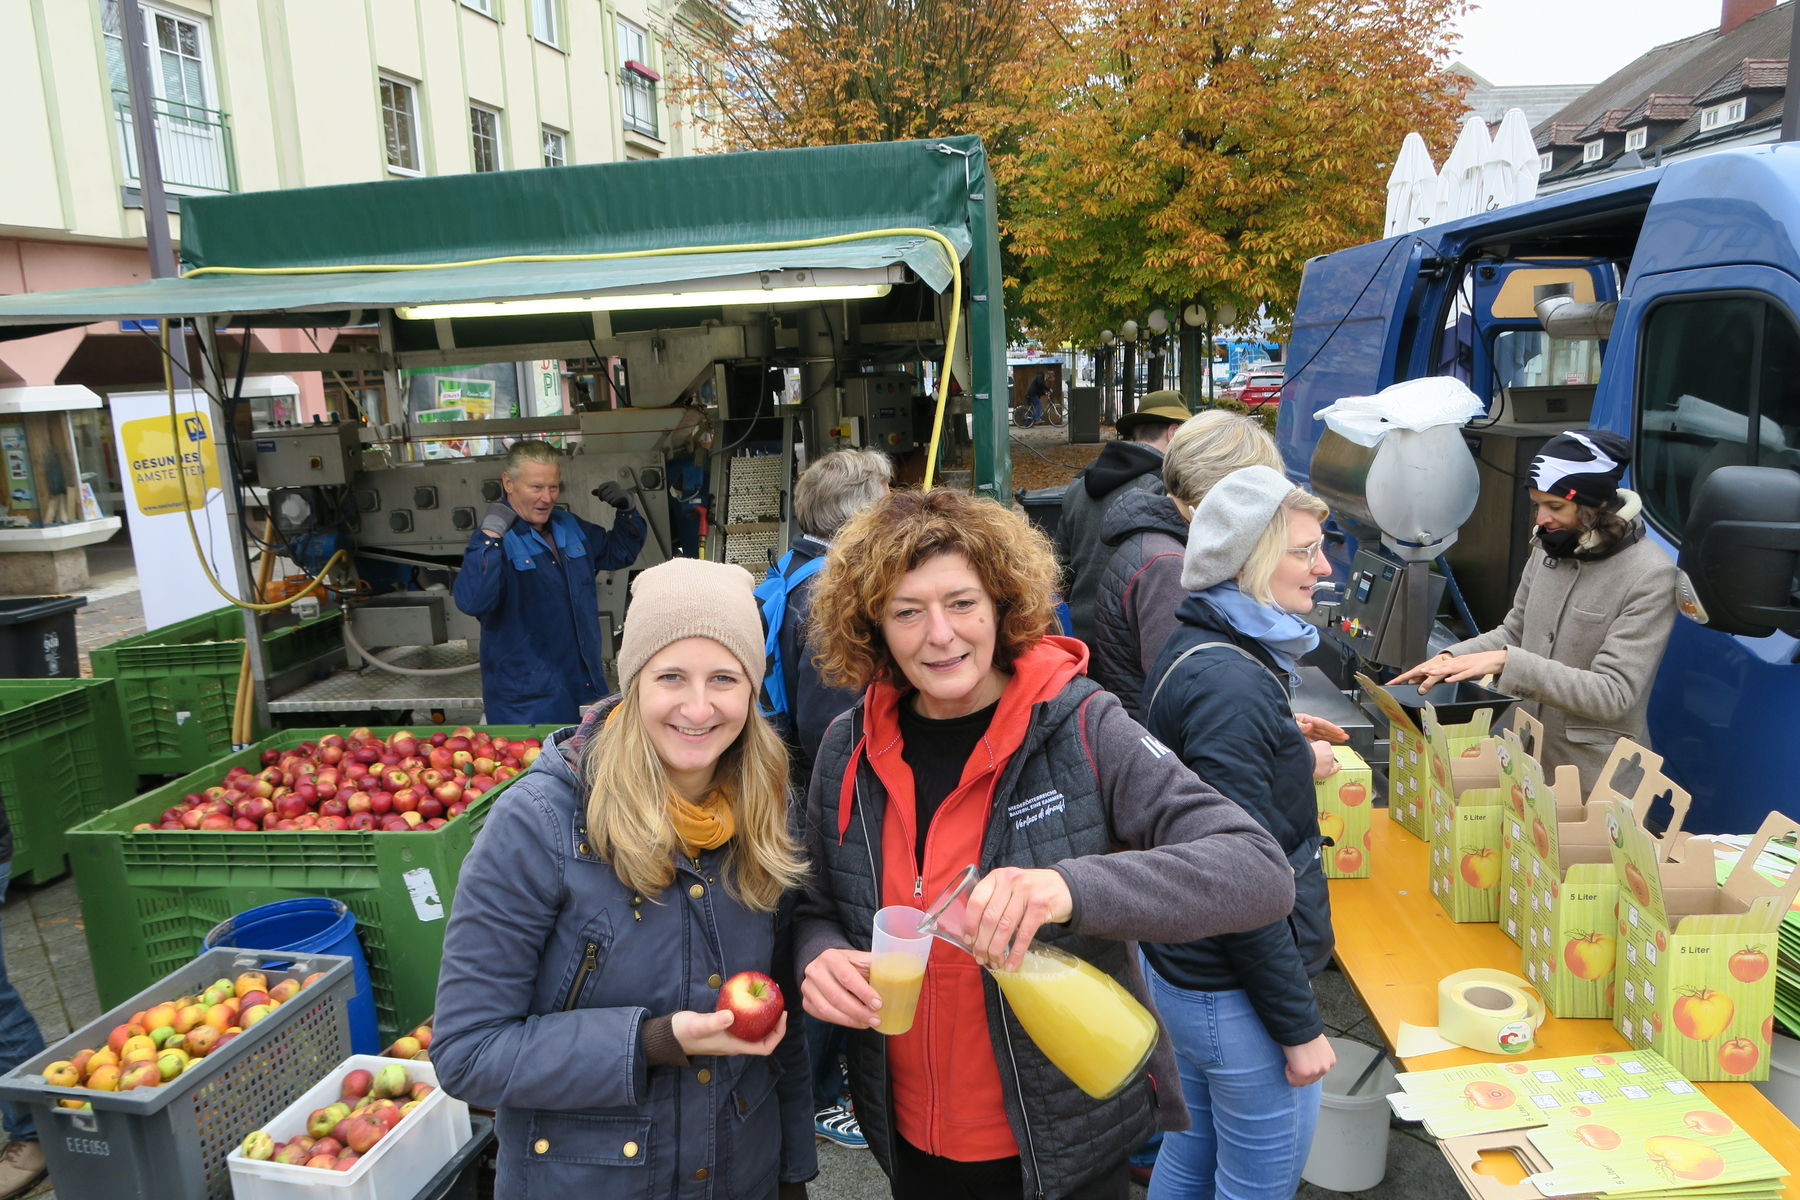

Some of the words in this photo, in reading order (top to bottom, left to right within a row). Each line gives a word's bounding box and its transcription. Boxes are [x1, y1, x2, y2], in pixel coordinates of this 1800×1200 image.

[136, 463, 206, 483] AMSTETEN
[1570, 893, 1576, 901] 5
[1577, 893, 1597, 901] Liter
[1680, 946, 1687, 954] 5
[1688, 946, 1711, 954] Liter
